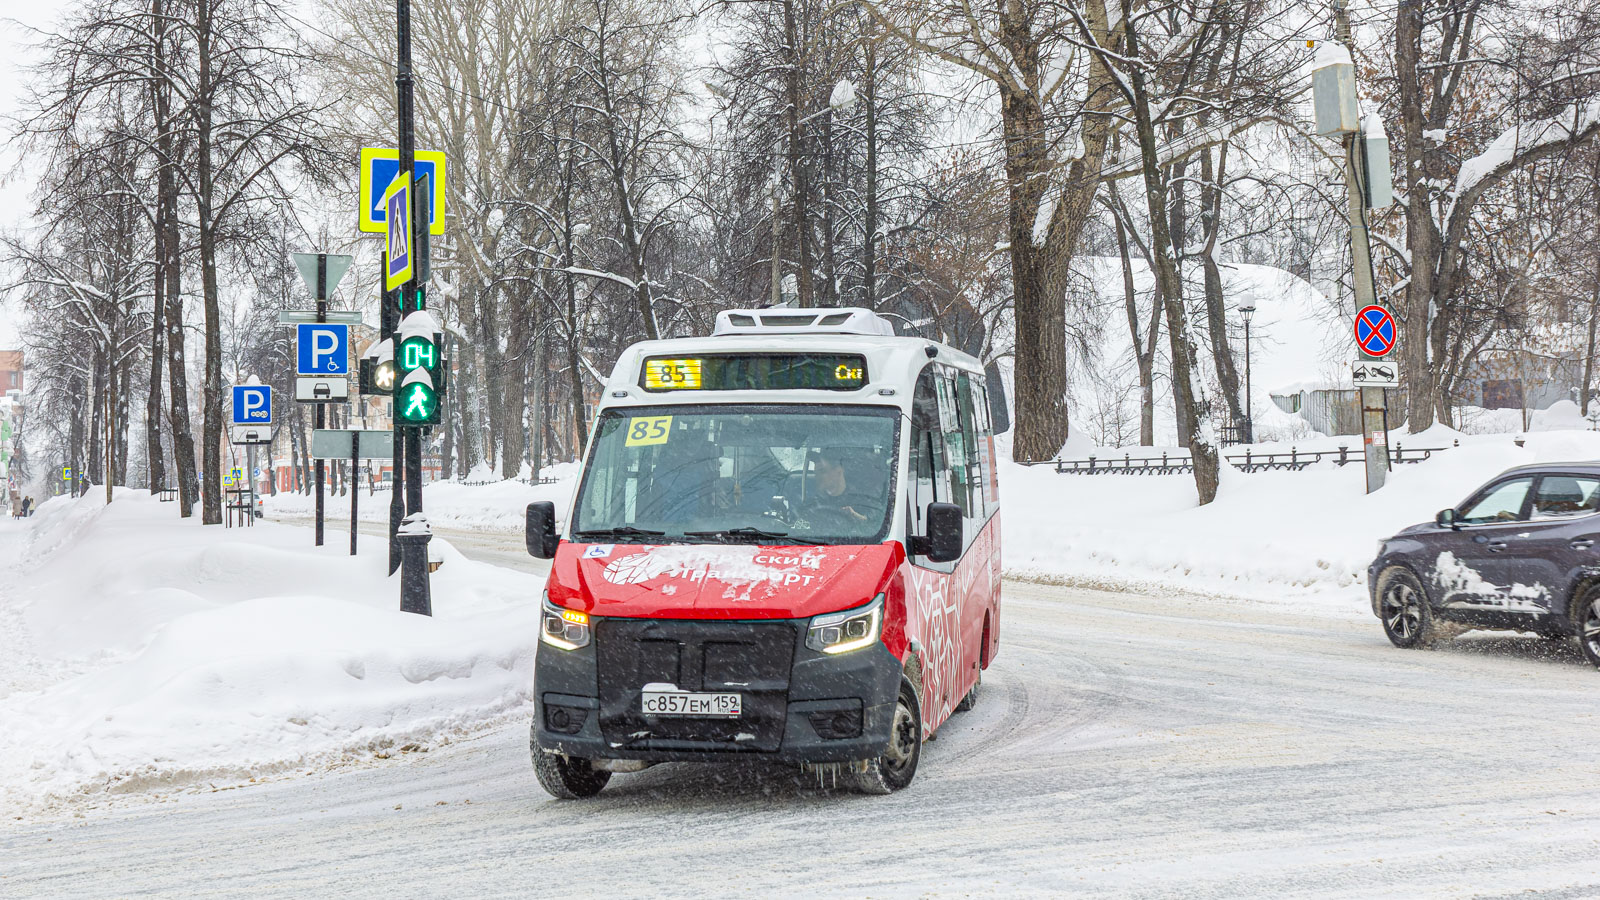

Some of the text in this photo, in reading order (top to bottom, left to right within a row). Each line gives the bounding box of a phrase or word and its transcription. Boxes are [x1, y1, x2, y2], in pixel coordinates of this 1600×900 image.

[312, 330, 339, 368] P
[405, 344, 433, 368] 04
[661, 365, 685, 382] 85
[244, 390, 264, 419] P
[631, 419, 667, 440] 85
[647, 696, 738, 712] С857ЕМ 159
